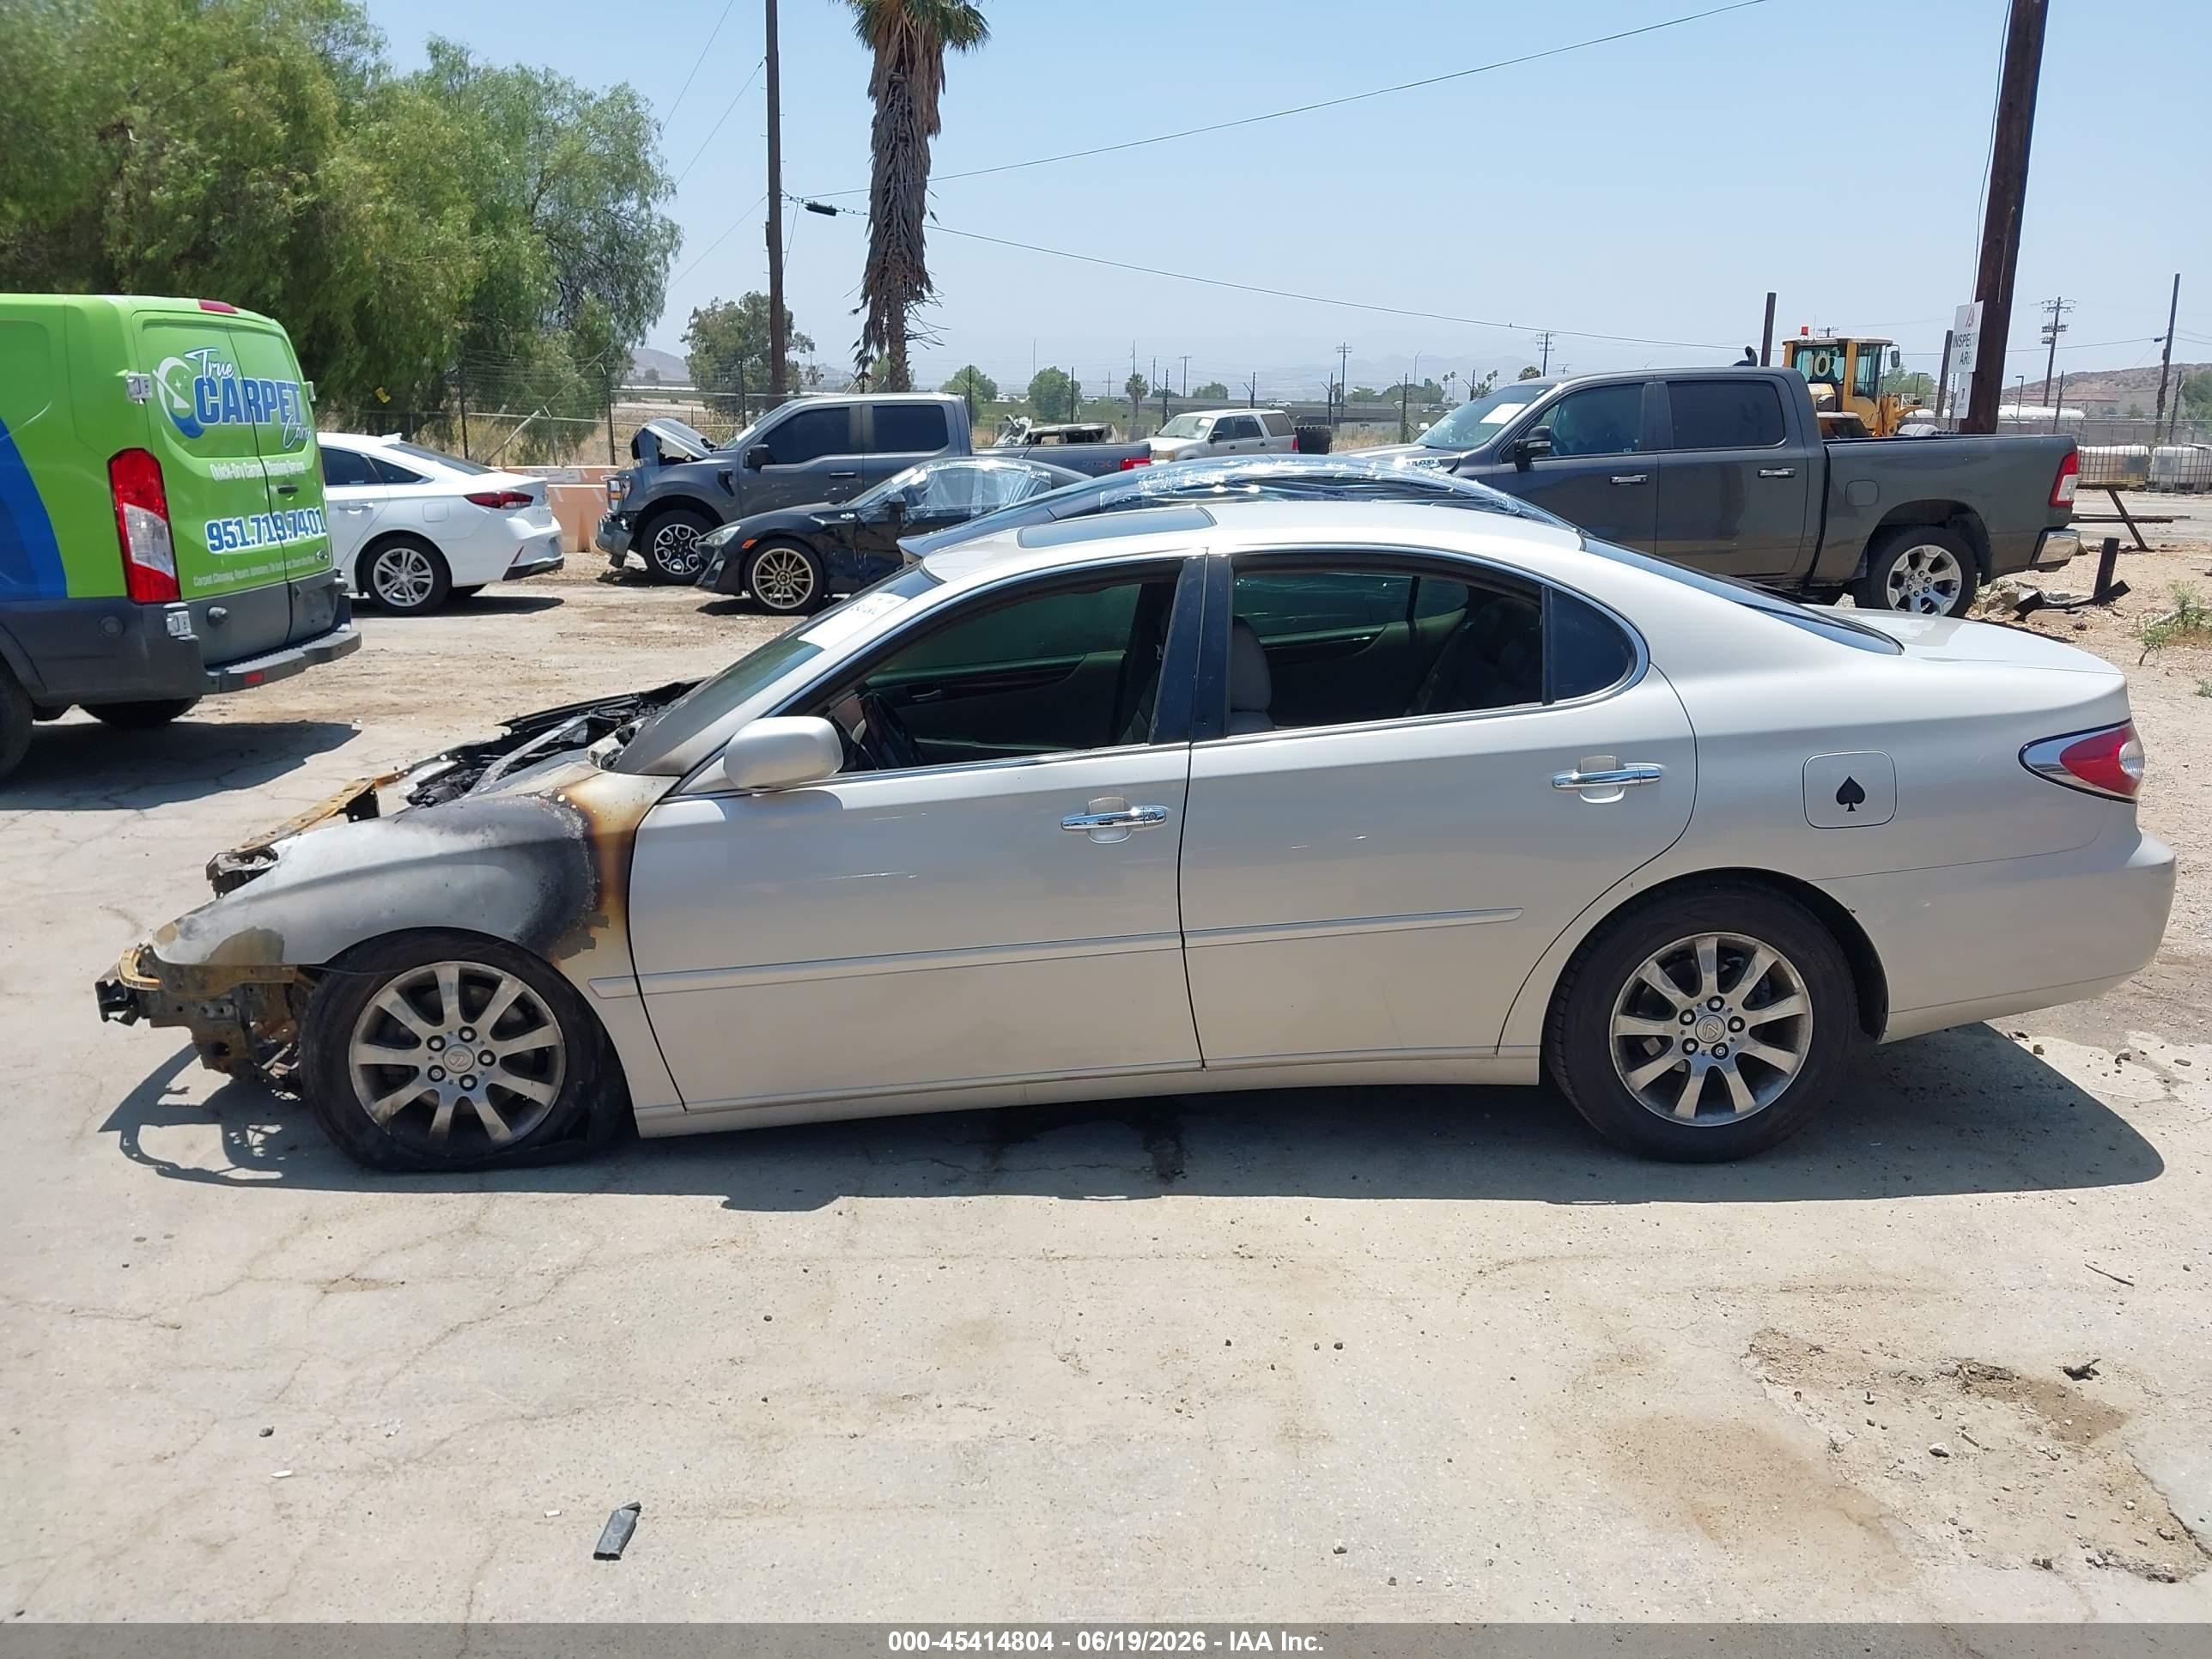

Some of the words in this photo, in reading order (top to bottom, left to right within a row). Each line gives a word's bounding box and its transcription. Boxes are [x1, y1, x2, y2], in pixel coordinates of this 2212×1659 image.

[184, 348, 234, 384] True
[193, 374, 302, 425] CARPET
[205, 507, 327, 555] 951.719.7401
